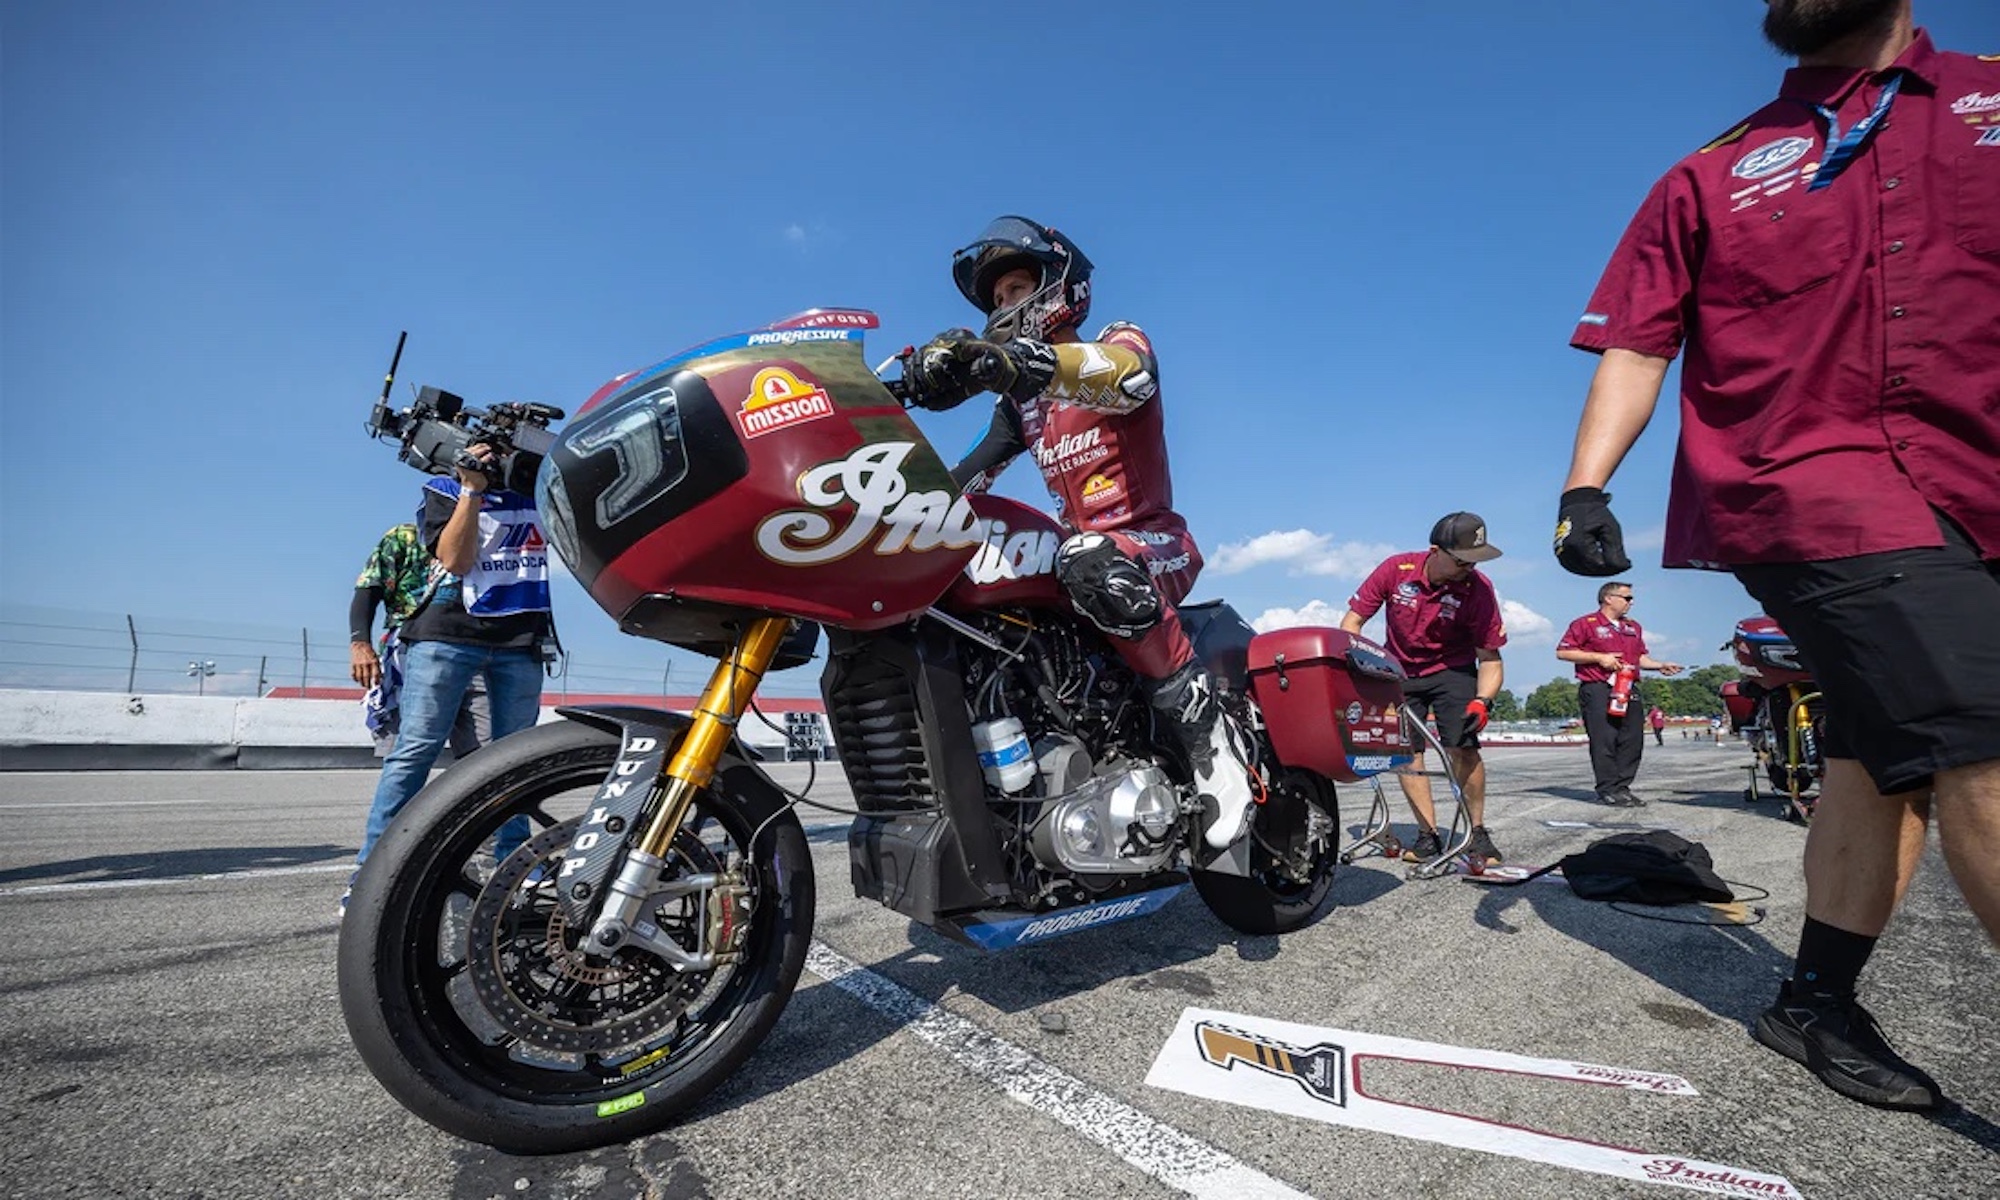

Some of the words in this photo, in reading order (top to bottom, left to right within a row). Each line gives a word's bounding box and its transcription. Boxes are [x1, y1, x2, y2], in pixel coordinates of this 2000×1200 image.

[1741, 139, 1800, 177] S&S
[747, 330, 849, 346] PROGRESSIVE
[745, 396, 816, 432] MISSION
[1031, 427, 1101, 466] Indian
[1074, 445, 1109, 467] RACING
[560, 737, 657, 877] DUNLOP
[1016, 898, 1146, 942] PROGRESSIVE
[1641, 1159, 1788, 1195] Indian
